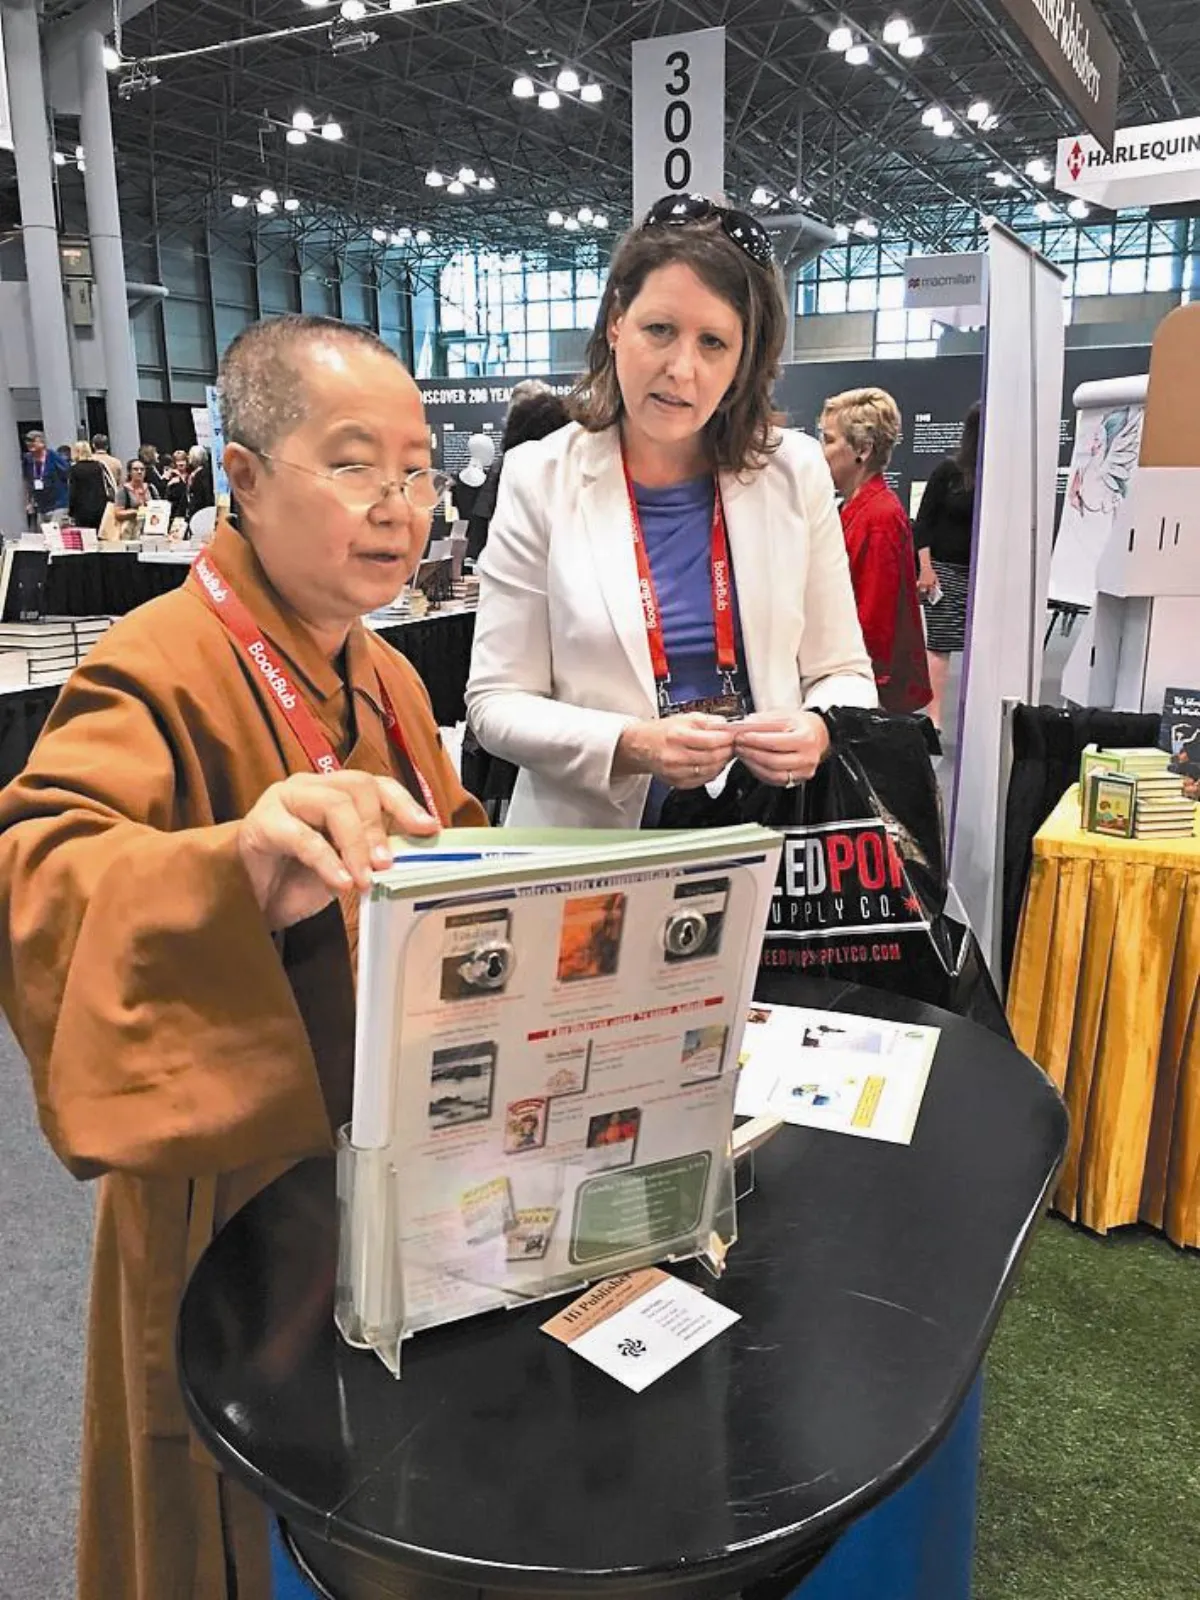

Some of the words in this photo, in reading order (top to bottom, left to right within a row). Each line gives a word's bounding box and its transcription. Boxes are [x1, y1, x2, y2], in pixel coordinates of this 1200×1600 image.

[1087, 134, 1200, 168] HARLEQUIN
[421, 388, 467, 405] ISCOVER
[247, 640, 297, 711] BookBub
[771, 896, 845, 925] UPPLY
